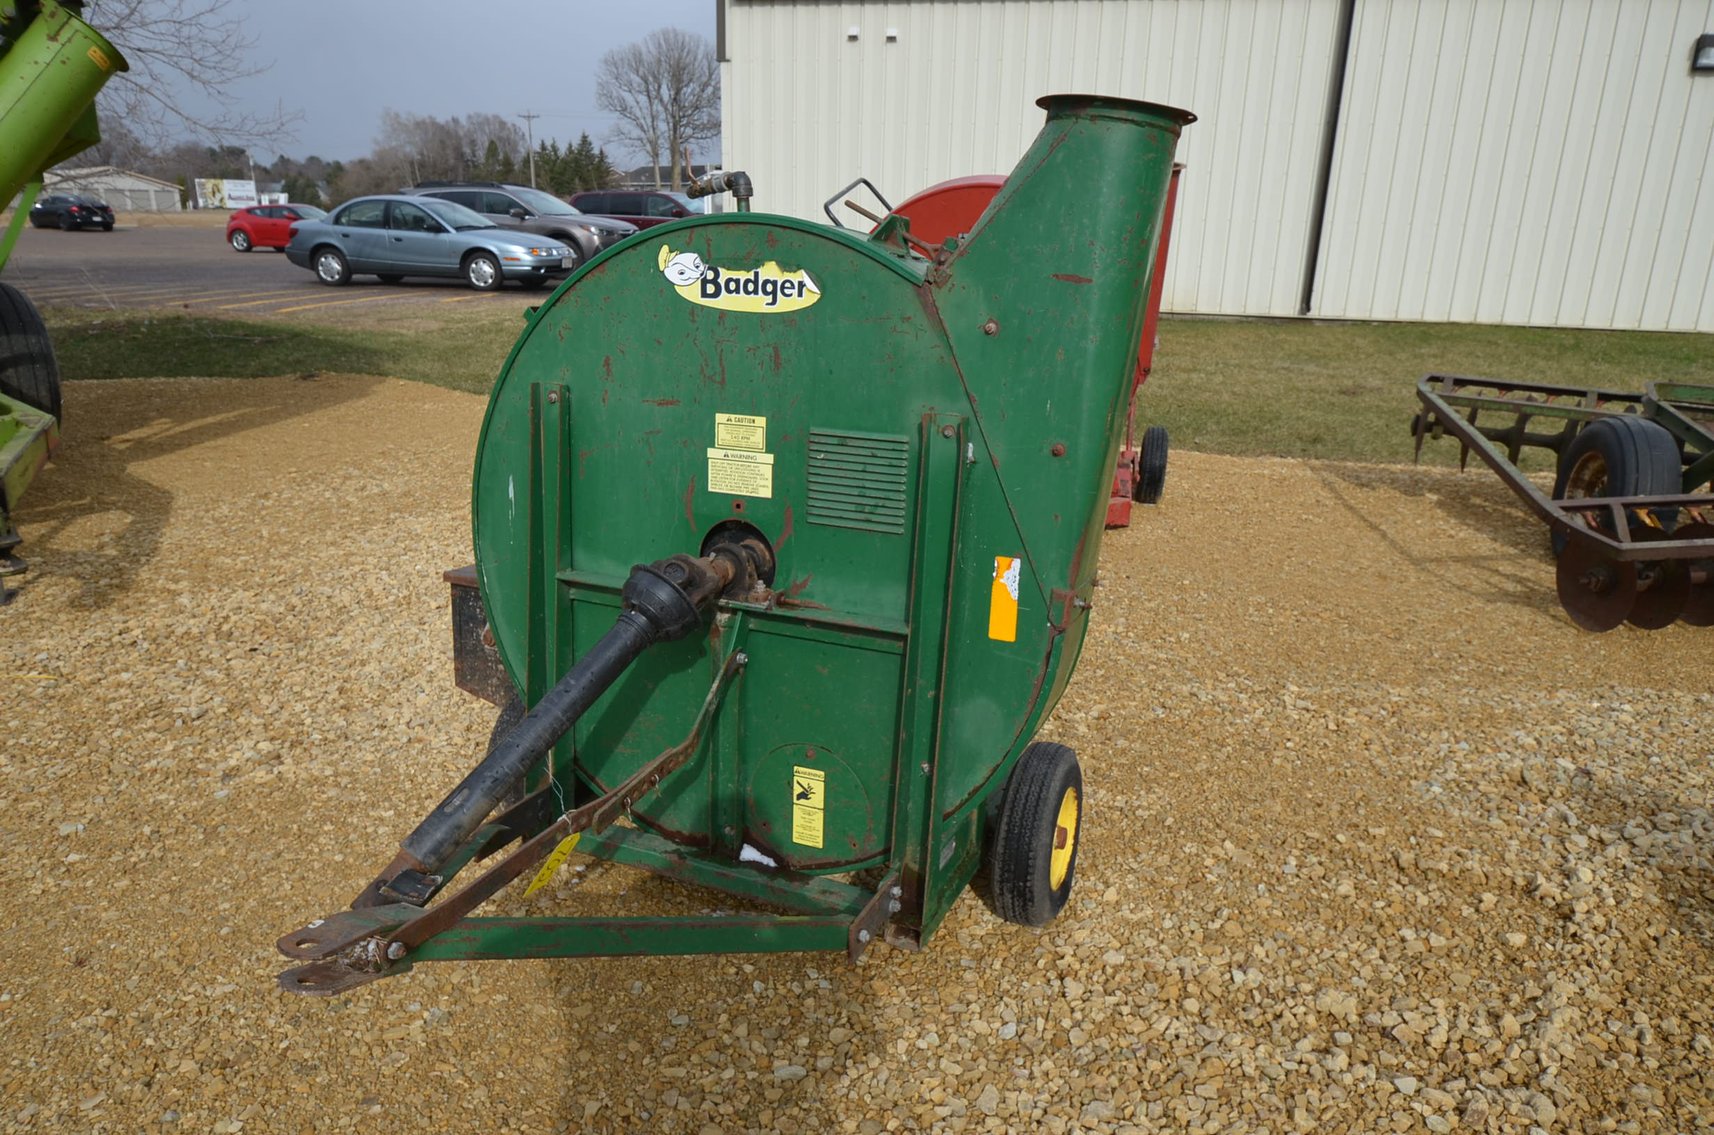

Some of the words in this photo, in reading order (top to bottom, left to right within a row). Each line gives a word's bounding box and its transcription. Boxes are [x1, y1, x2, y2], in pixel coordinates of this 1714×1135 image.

[700, 266, 807, 306] Badger
[734, 416, 756, 425] CAUTION
[730, 452, 757, 461] WARNING
